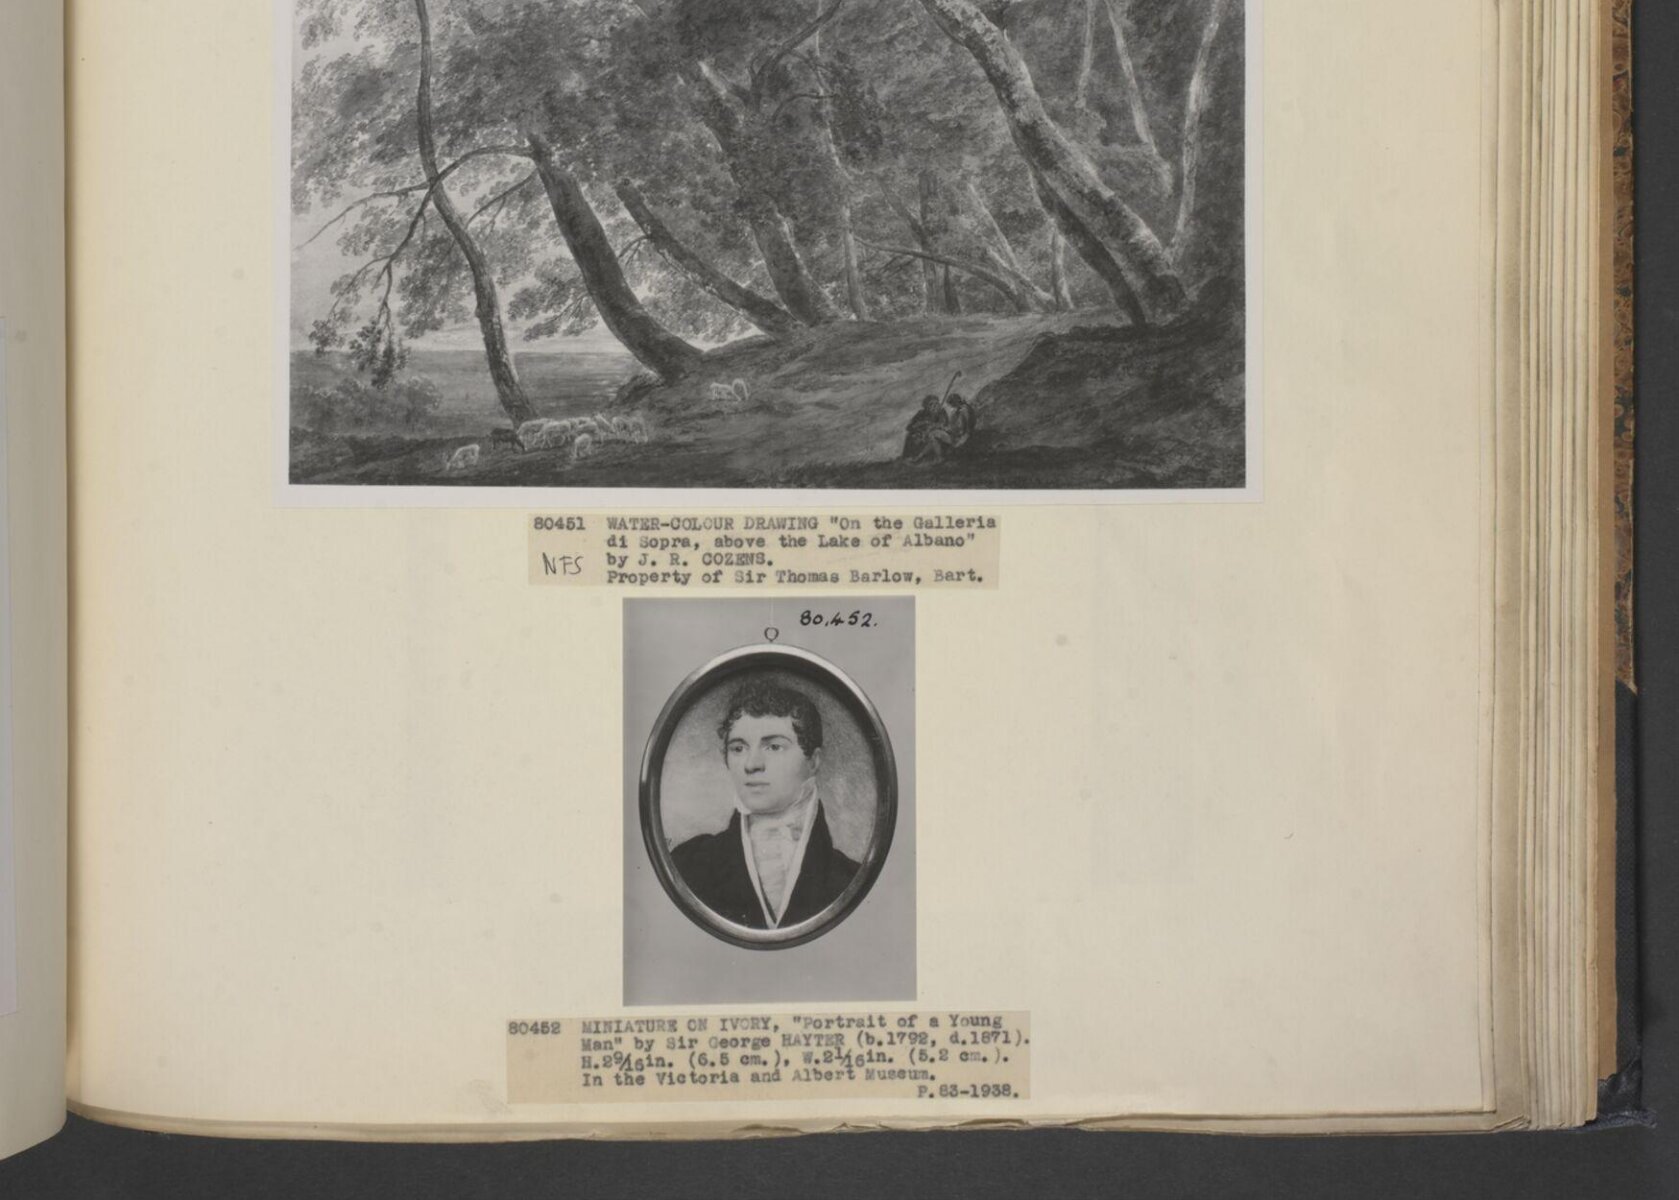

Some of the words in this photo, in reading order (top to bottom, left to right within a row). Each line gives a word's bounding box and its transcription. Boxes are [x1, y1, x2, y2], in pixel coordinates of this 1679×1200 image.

[533, 517, 586, 530] 80451
[606, 517, 735, 531] WATER-COLOUR
[743, 517, 820, 530] DRAWING
[829, 517, 862, 530] "On
[872, 517, 904, 529] the
[912, 516, 997, 529] Galleria
[606, 535, 629, 548] di
[639, 536, 701, 550] Sopra,
[713, 535, 767, 548] above
[778, 535, 808, 548] the
[817, 535, 861, 547] Lake
[870, 534, 893, 547] of
[902, 533, 976, 547] Albano"
[541, 552, 585, 575] NFS
[606, 553, 629, 568] by
[637, 553, 657, 566] J.
[669, 553, 689, 566] R.
[701, 553, 774, 566] COZENS.
[606, 570, 692, 586] Property
[701, 570, 724, 583] of
[734, 570, 767, 583] Sir
[775, 570, 840, 583] Thomas
[848, 569, 923, 585] Barlow,
[933, 569, 984, 582] Bart.
[507, 1021, 562, 1035] 80452
[581, 1019, 679, 1034] MINIATURE
[686, 1018, 708, 1032] ON
[719, 1017, 780, 1033] IVORY,
[792, 1015, 888, 1029] "Portrait
[896, 1015, 919, 1028] of
[929, 1017, 940, 1028] a
[948, 1015, 1004, 1029] Young
[580, 1037, 623, 1051] Man"
[633, 1037, 656, 1051] by
[665, 1036, 700, 1050] Sir
[708, 1035, 771, 1051] George
[781, 1033, 846, 1047] HAYTER
[856, 1030, 937, 1047] (b.1792,
[949, 1030, 1030, 1046] d.1871).
[689, 1051, 730, 1069] (6.5
[739, 1050, 791, 1068] cm.),
[909, 1048, 950, 1065] (5.2
[959, 1049, 1010, 1063] cm.).
[581, 1073, 604, 1087] In
[614, 1072, 646, 1086] the
[655, 1071, 741, 1086] Victoria
[750, 1071, 782, 1083] and
[791, 1066, 857, 1081] Albert
[864, 1068, 937, 1081] Museum.
